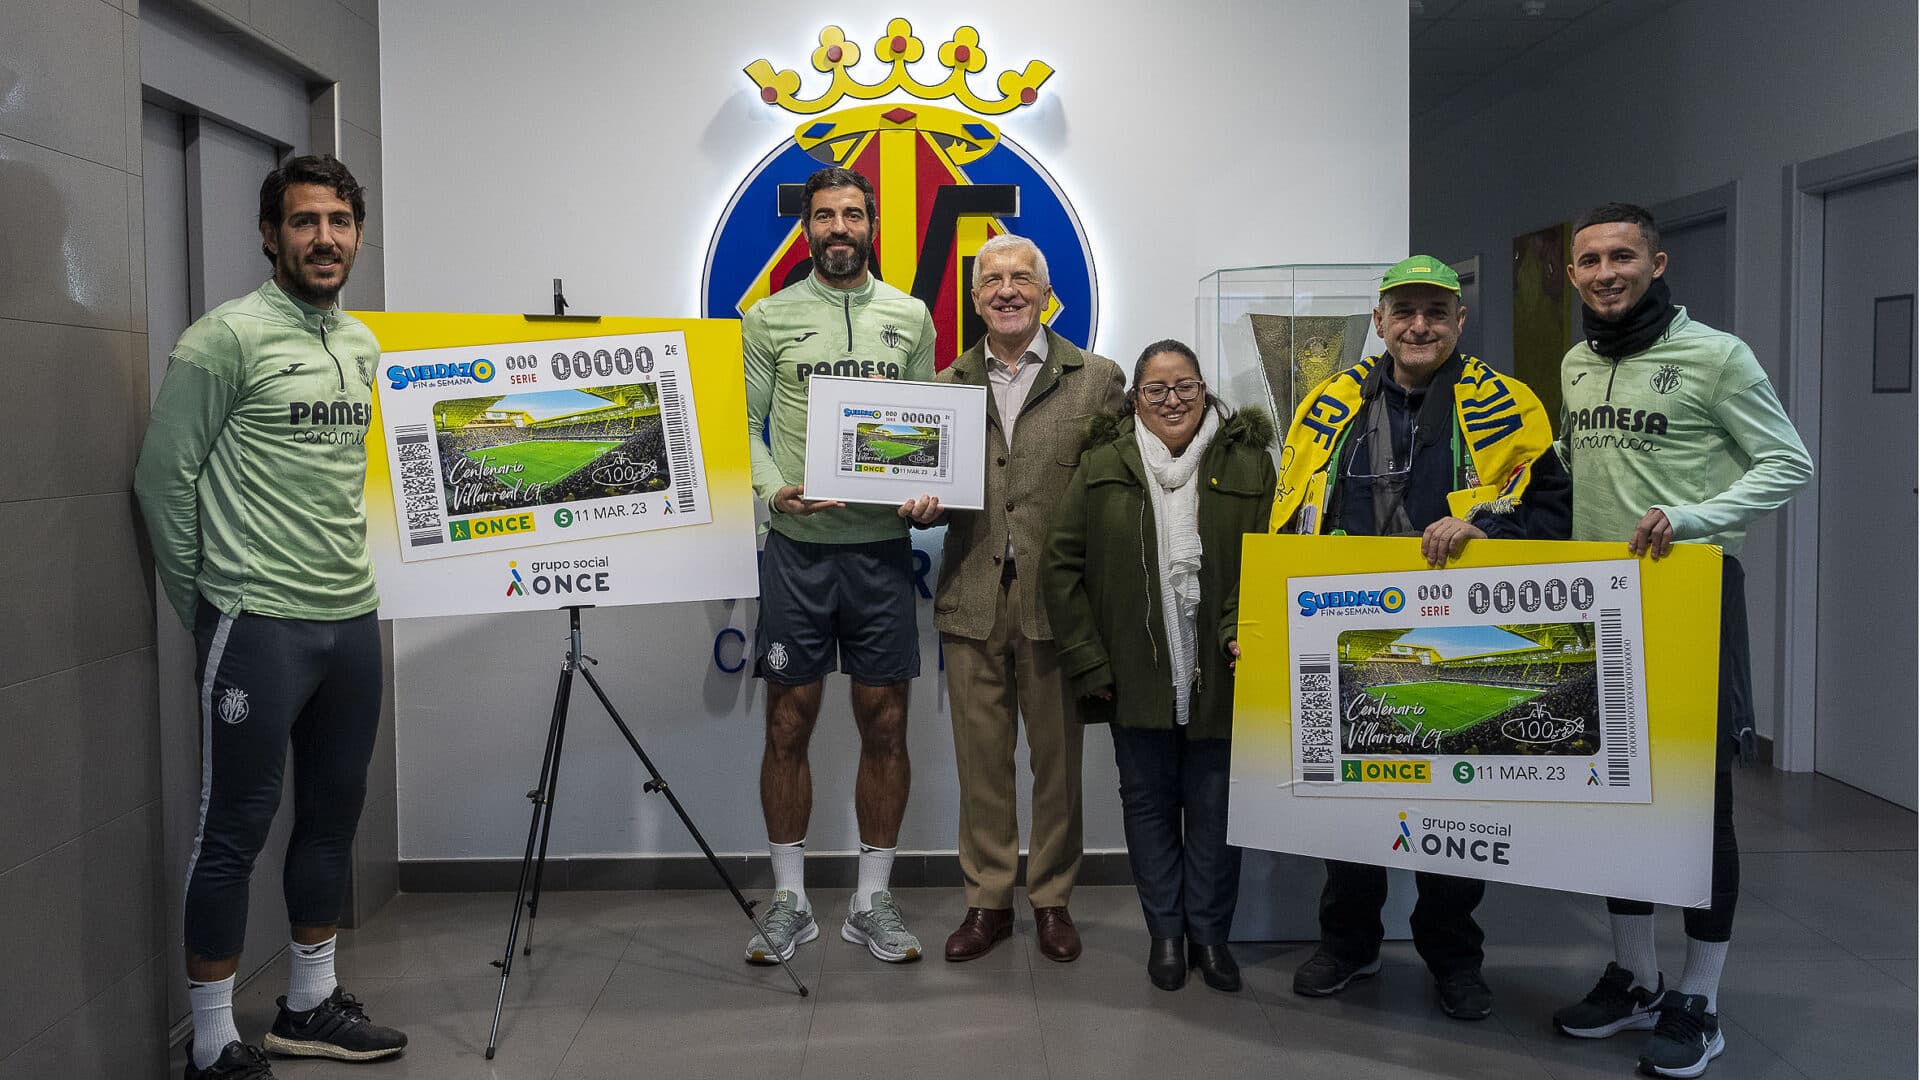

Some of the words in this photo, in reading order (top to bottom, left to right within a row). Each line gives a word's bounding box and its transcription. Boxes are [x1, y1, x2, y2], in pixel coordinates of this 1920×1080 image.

[664, 344, 678, 355] 2€
[505, 354, 538, 370] 000
[551, 346, 654, 380] 00000
[387, 358, 495, 390] SUELDAZO
[437, 378, 472, 387] SEMANA
[510, 373, 538, 384] SERIE
[1570, 405, 1669, 435] PAMESA
[450, 455, 524, 484] Centenario
[605, 466, 634, 482] 100
[454, 478, 523, 510] Villarreal
[575, 509, 589, 521] 11
[594, 505, 629, 520] MAR.
[631, 502, 647, 515] 23
[475, 516, 531, 535] ONCE
[532, 560, 570, 573] grupo
[573, 556, 609, 568] social
[533, 572, 610, 594] ONCE
[1418, 584, 1453, 600] 000
[1610, 576, 1628, 589] 2€
[1298, 586, 1406, 617] SUELDAZO
[1468, 577, 1594, 615] 00000
[1345, 607, 1380, 615] SEMANA
[1421, 605, 1450, 616] SERIE
[1347, 692, 1426, 721] Centenario
[1348, 721, 1423, 749] Villarreal
[1519, 721, 1553, 739] 100
[1366, 764, 1426, 779] ONCE
[1477, 766, 1493, 779] 11
[1500, 766, 1542, 780] MAR.
[1546, 766, 1565, 780] 23
[1422, 817, 1466, 832] grupo
[1469, 823, 1511, 837] social
[1421, 834, 1510, 865] ONCE
